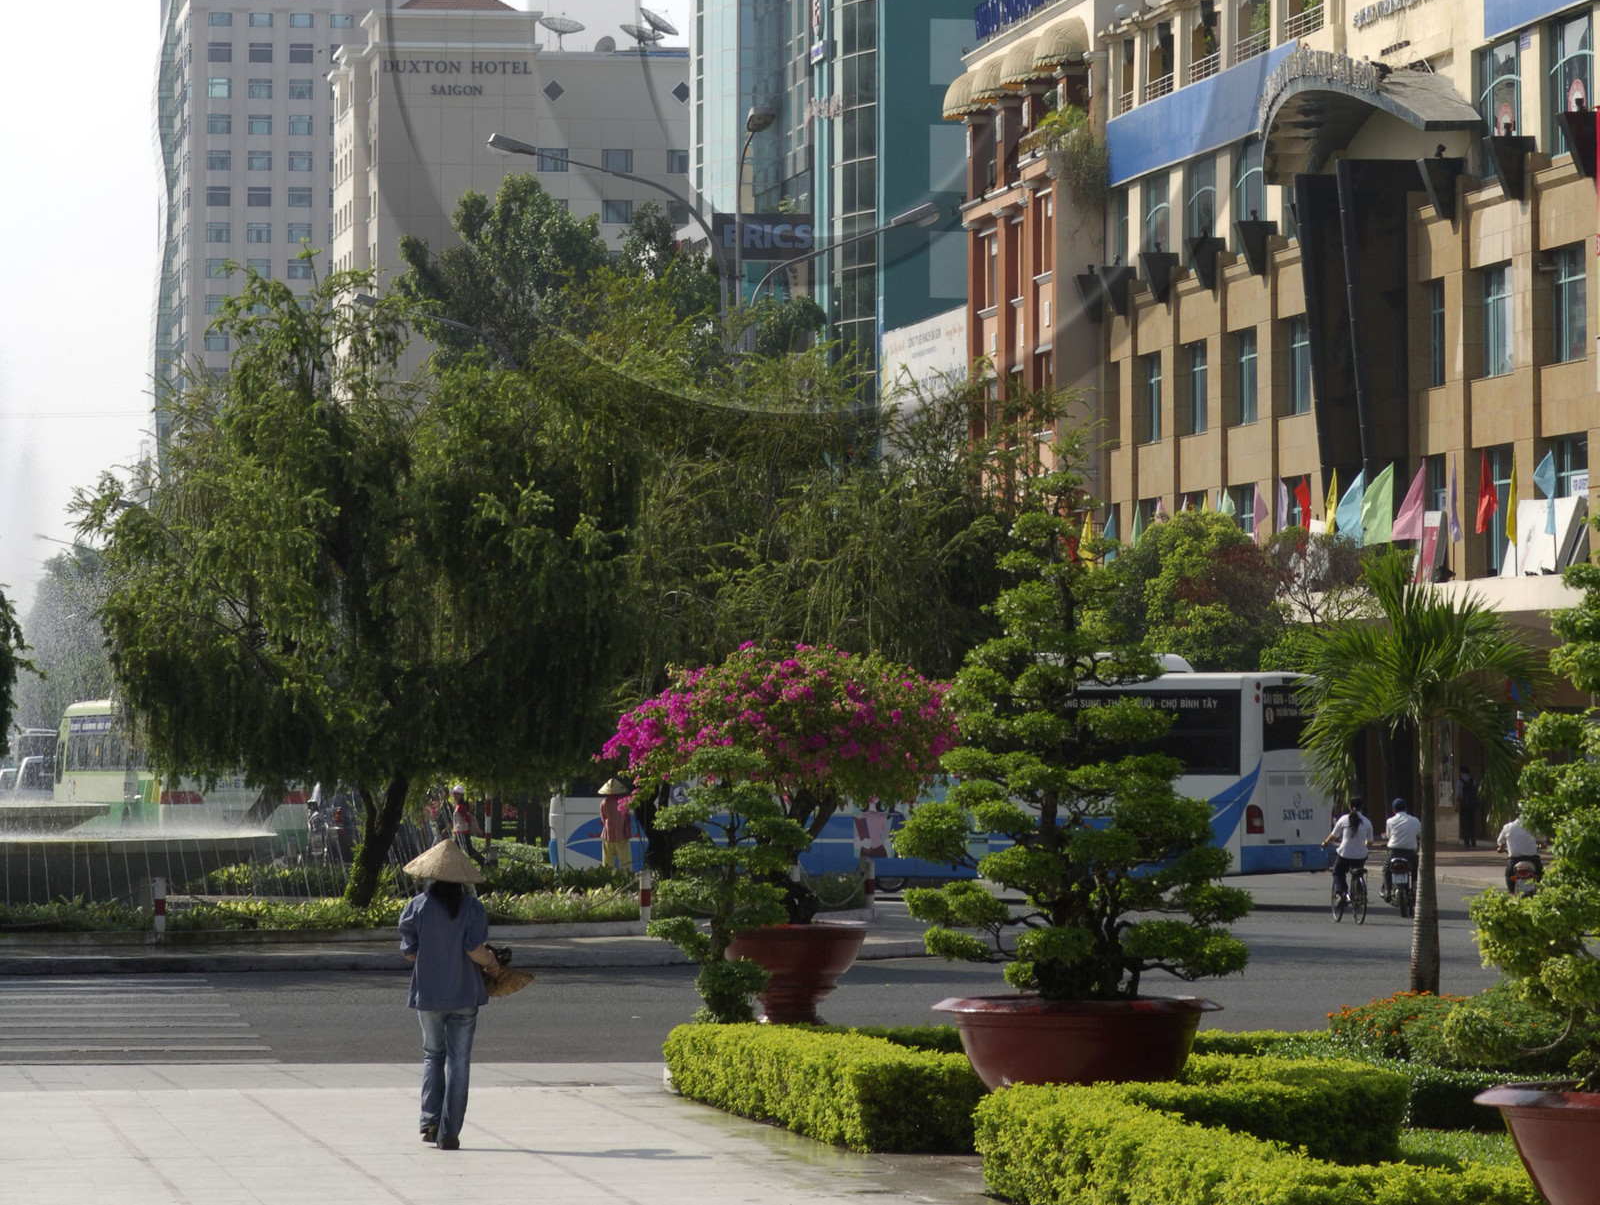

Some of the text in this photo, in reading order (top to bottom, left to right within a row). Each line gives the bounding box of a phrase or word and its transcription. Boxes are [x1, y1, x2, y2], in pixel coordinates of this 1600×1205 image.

[382, 60, 533, 75] DUXTON HOTEL
[431, 84, 483, 96] SAIGON
[724, 224, 815, 249] ERICS
[1161, 698, 1178, 710] CHỢ
[1181, 697, 1199, 708] BÌNH
[1203, 697, 1218, 708] TÂY
